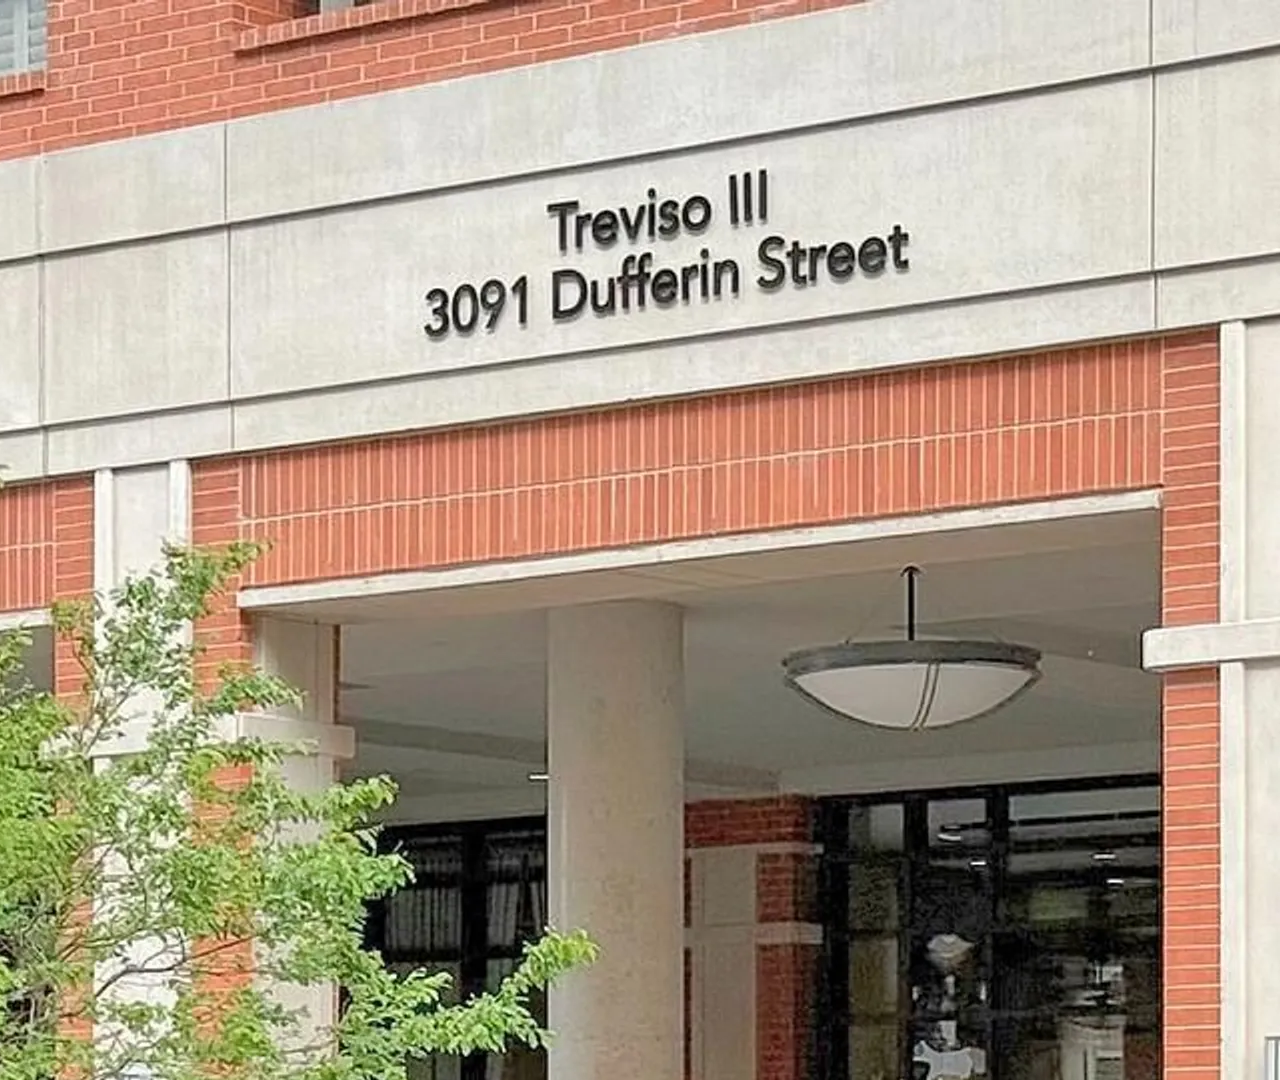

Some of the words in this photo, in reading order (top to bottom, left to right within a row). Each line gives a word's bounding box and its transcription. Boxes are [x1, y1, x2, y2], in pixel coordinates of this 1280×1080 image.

[547, 188, 712, 252] Treviso
[727, 169, 769, 226] III
[423, 276, 528, 338] 3091
[551, 249, 739, 322] Dufferin
[757, 223, 910, 291] Street
